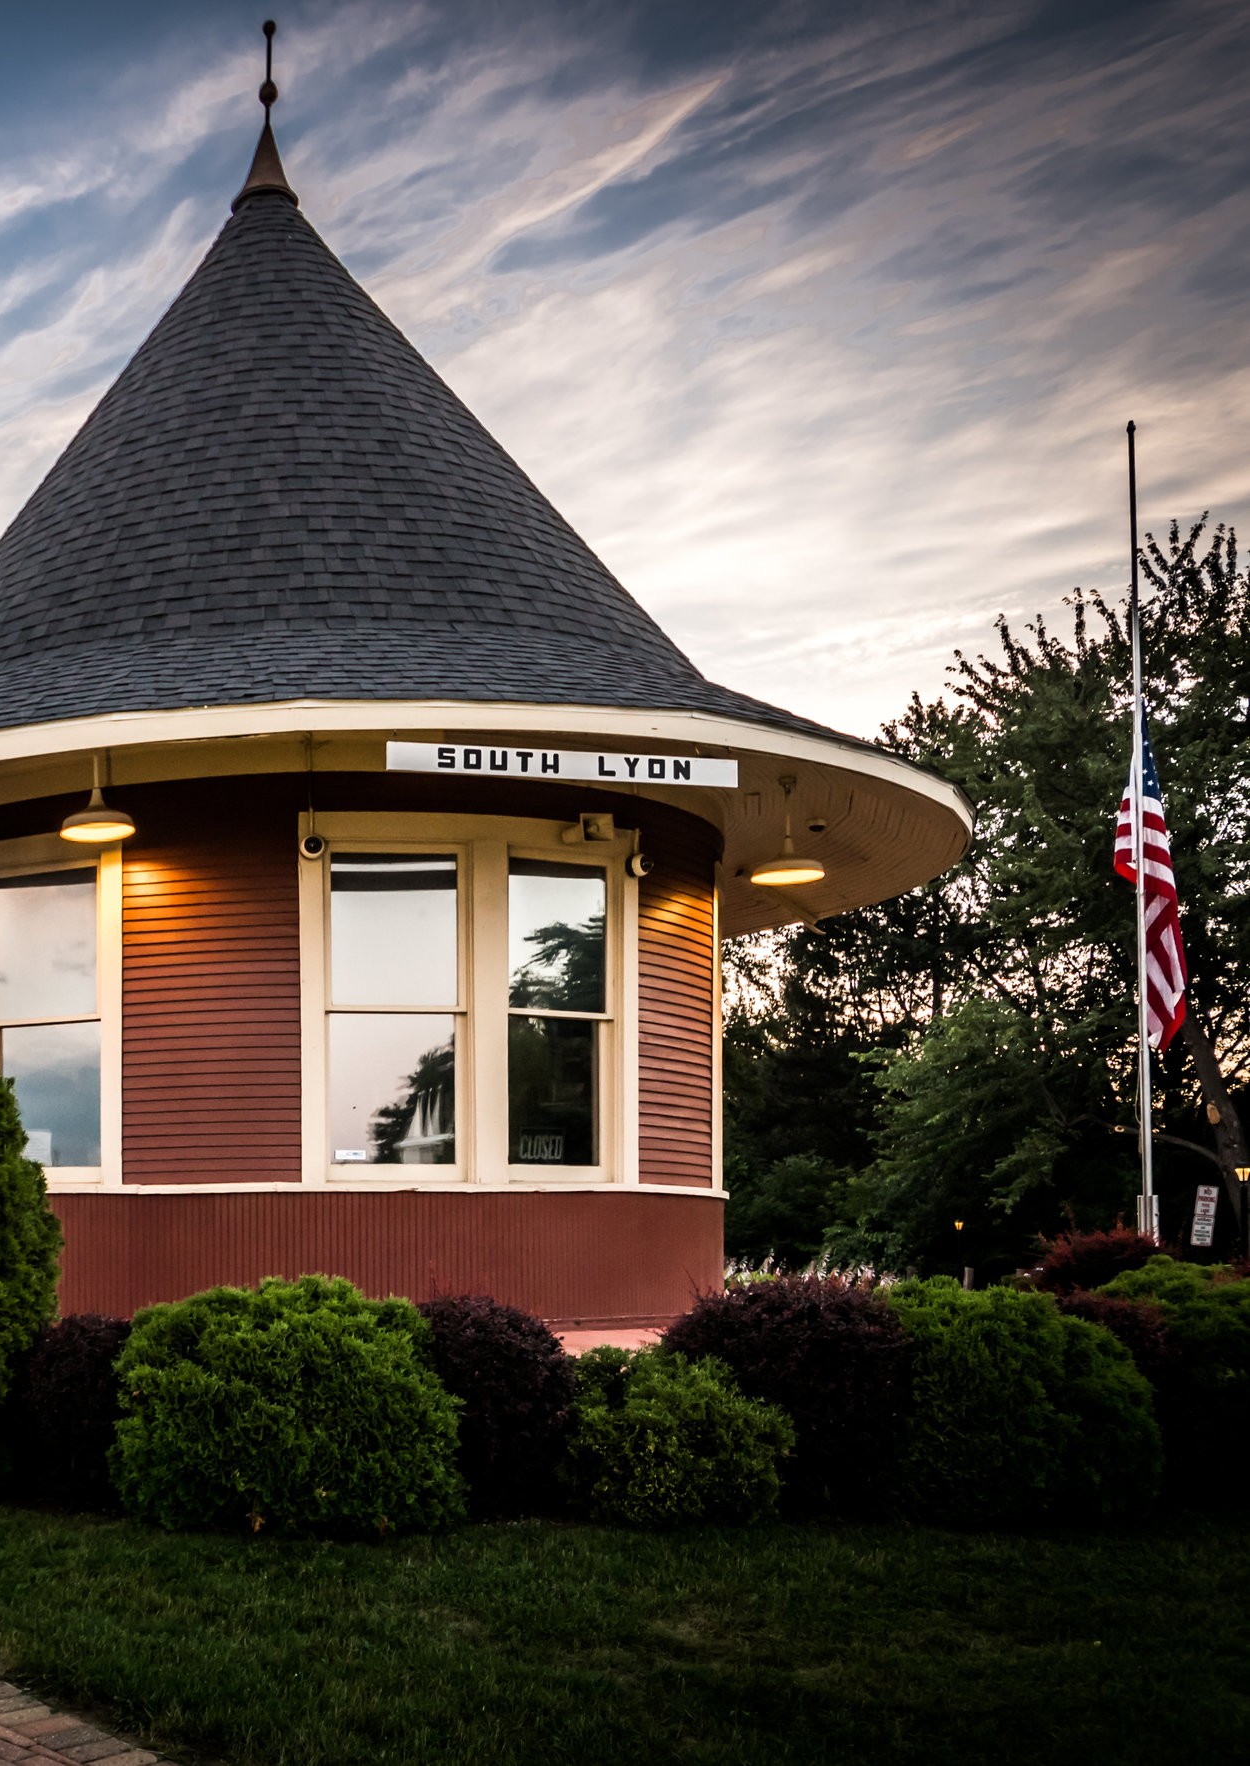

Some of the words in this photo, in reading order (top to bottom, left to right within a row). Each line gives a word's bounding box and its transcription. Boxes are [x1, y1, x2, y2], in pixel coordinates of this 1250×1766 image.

[437, 747, 560, 774] SOUTH
[598, 755, 691, 780] LYON
[519, 1134, 564, 1160] CLOSED
